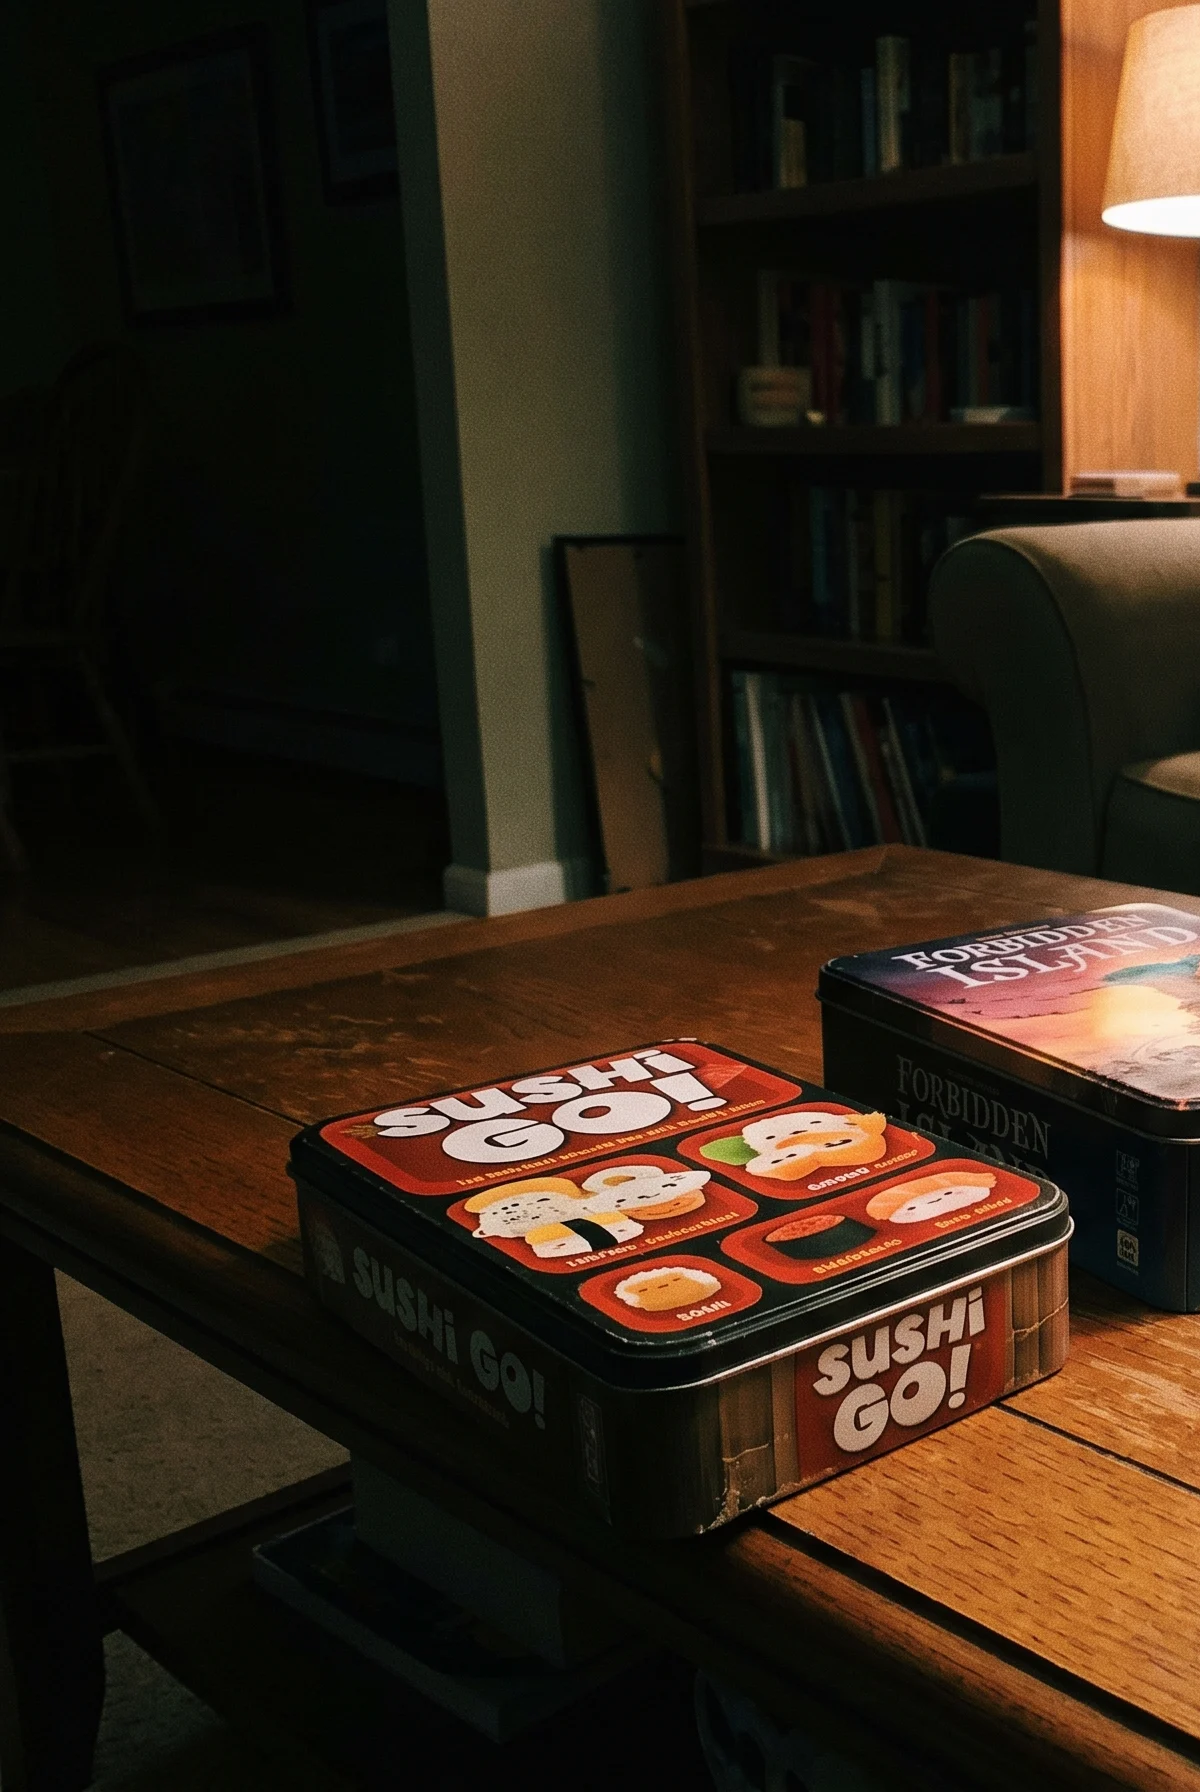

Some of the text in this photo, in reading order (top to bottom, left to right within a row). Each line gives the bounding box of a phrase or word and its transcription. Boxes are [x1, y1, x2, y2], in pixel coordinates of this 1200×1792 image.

[891, 914, 1153, 970] FORBIDDEN
[442, 1072, 728, 1163] GO!
[896, 1054, 1051, 1160] FORBIDDEN
[469, 1329, 546, 1430] GO!
[834, 1344, 972, 1452] GO!
